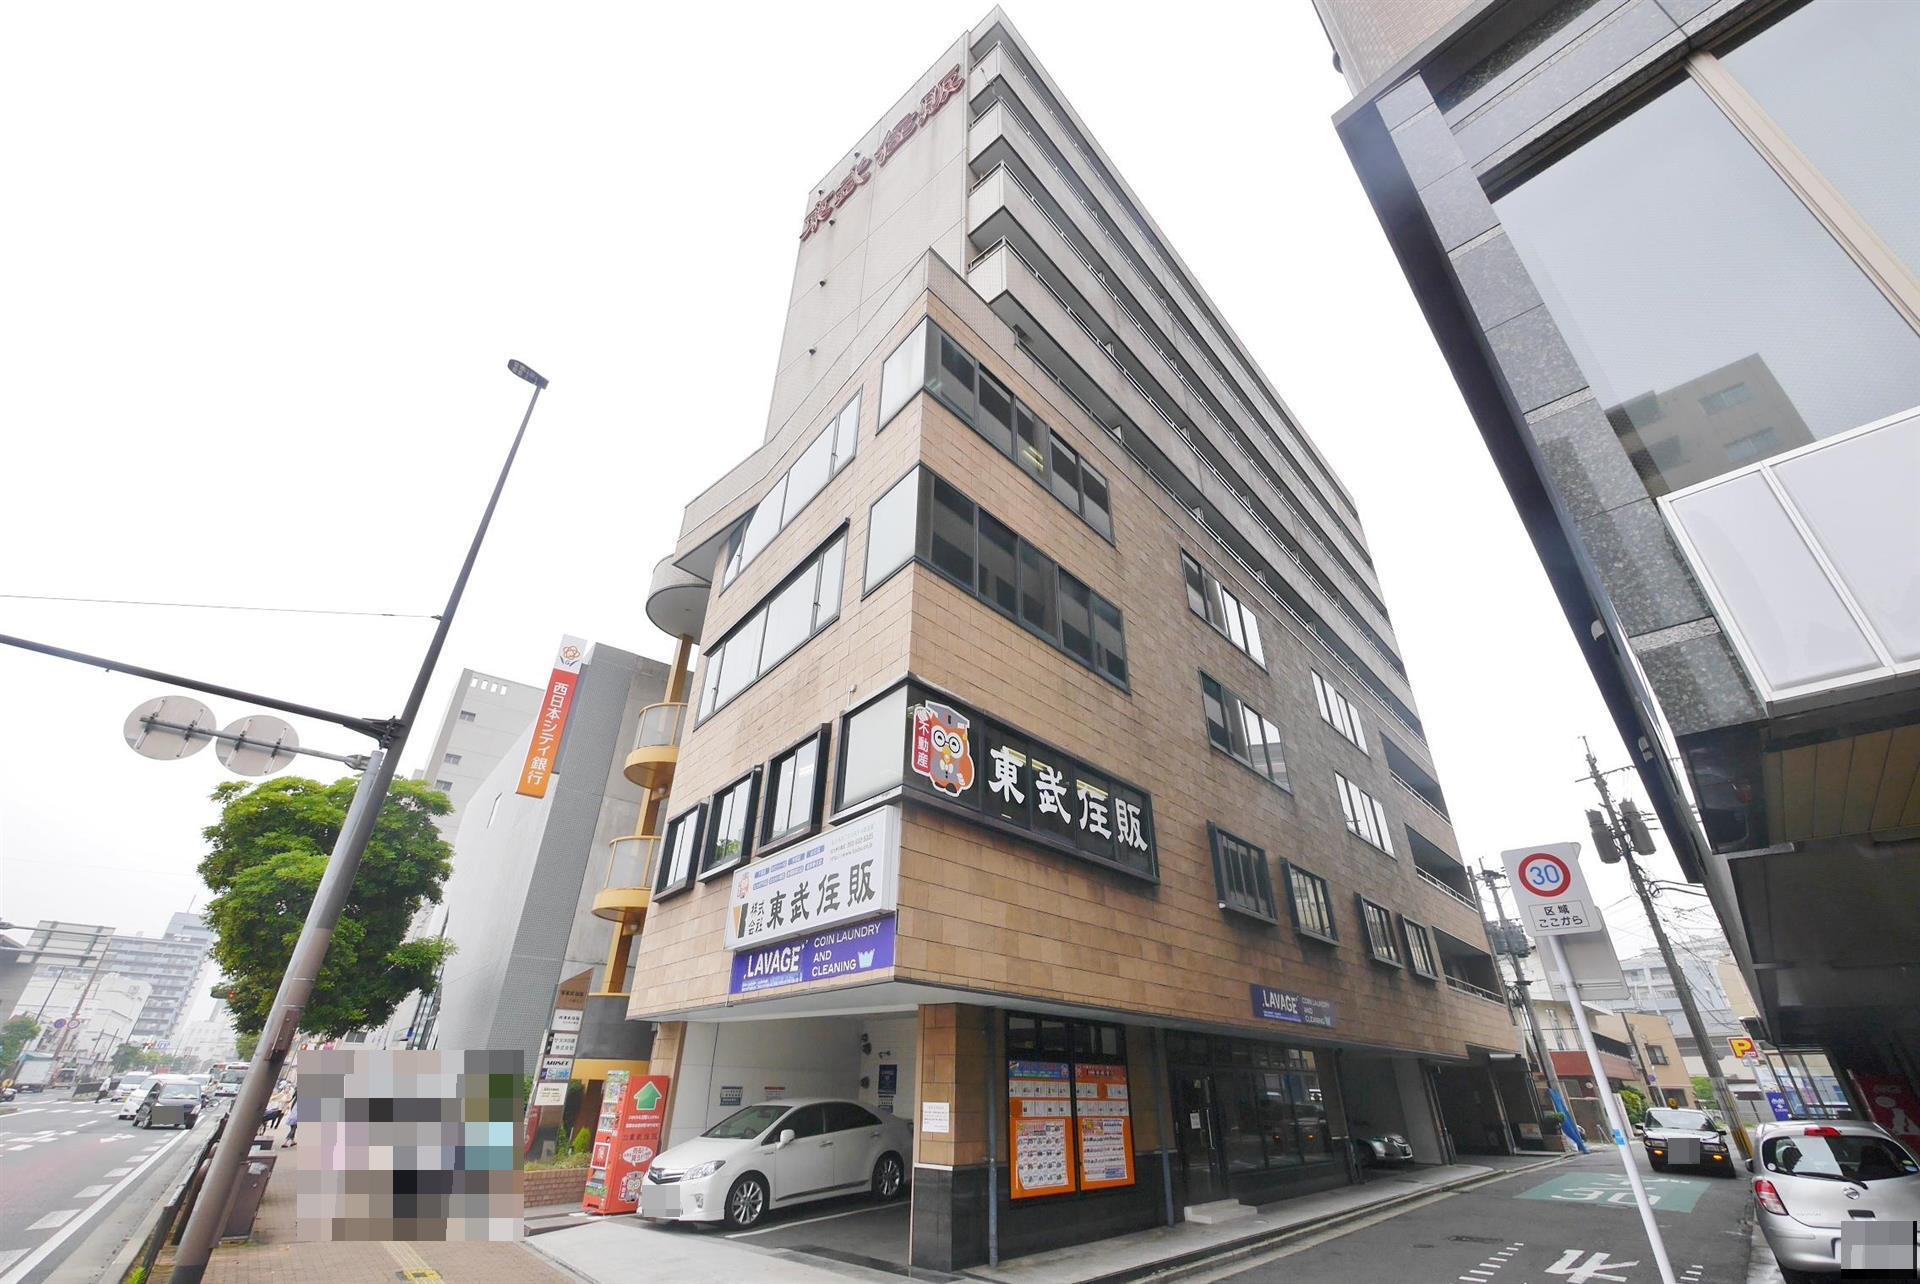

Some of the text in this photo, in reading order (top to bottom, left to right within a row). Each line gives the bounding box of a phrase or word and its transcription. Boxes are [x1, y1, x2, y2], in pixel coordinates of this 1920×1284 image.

[527, 681, 568, 786] 西日本シティ銀行
[917, 719, 930, 769] 不動産
[988, 745, 1148, 852] 東武住販
[1529, 864, 1560, 885] 30
[766, 859, 876, 930] 東武住販
[1538, 915, 1583, 928] ここから
[1544, 904, 1570, 916] 区域
[814, 922, 882, 948] COIN LAUNDRY
[746, 946, 801, 979] LAVAGE
[812, 959, 857, 977] CLEANING
[813, 950, 832, 963] AND
[1262, 989, 1298, 1014] LAVAGE
[1732, 1039, 1754, 1058] P
[1551, 1189, 1662, 1206] 30
